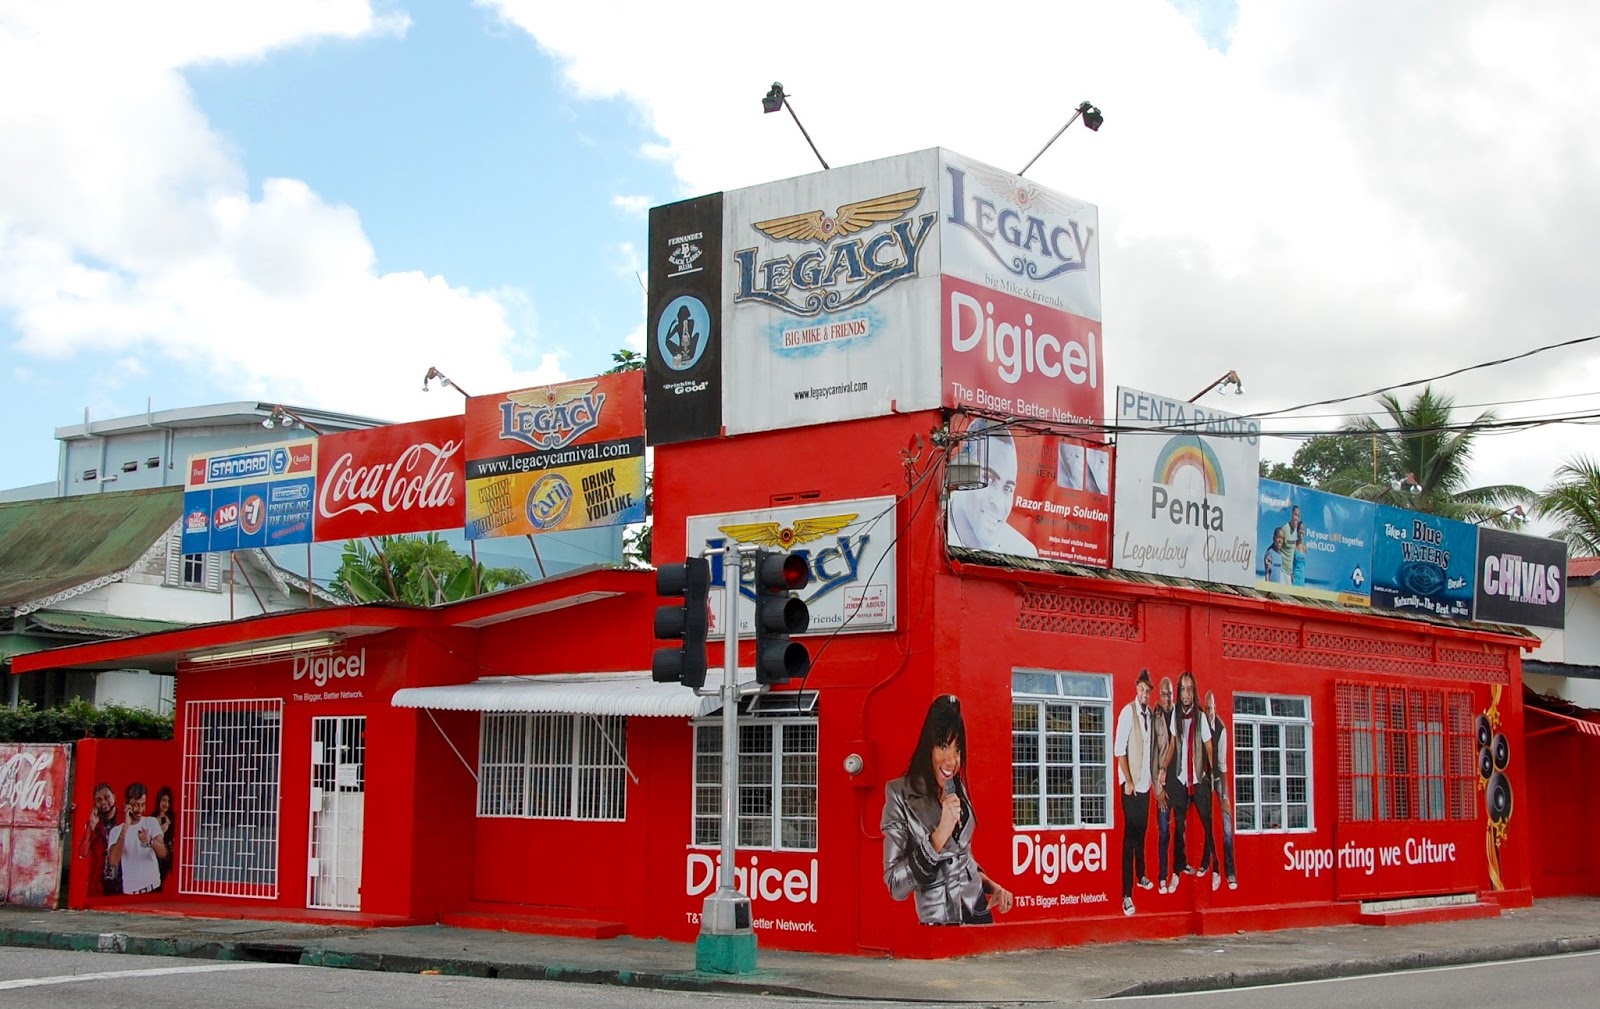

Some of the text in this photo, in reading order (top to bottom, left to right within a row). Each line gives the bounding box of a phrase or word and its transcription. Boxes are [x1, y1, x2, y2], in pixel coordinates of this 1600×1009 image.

[945, 165, 1094, 276] LEGACY
[668, 232, 703, 246] FERNANDES
[678, 263, 693, 271] RUM
[734, 212, 938, 312] LEGACY
[985, 273, 1064, 307] big Mike & Friends
[785, 319, 866, 346] BIG MIKE & FRIENDS
[951, 290, 1097, 389] Digicel
[794, 381, 868, 400] www.legacycarnival.com
[951, 382, 973, 401] The
[976, 388, 1014, 414] Bigger,
[1017, 399, 1050, 418] Better
[499, 393, 606, 446] LEGACY
[1123, 391, 1258, 446] PENTA PAINTS
[212, 456, 267, 476] STANDARD
[275, 453, 283, 469] S
[478, 442, 631, 475] www.legacycarnival.com
[319, 438, 464, 519] Coca-Cola
[478, 478, 509, 504] KNOW
[581, 467, 616, 492] DRINK
[487, 493, 512, 516] WHO
[530, 483, 573, 528] Carib
[584, 483, 615, 507] WHAT
[586, 502, 609, 521] YOU
[609, 493, 637, 514] LIKE.
[1015, 496, 1109, 522] Razor Bump Solution
[1151, 486, 1224, 532] Penta
[473, 515, 495, 535] YOU
[1384, 518, 1443, 546] Take a Blue
[1122, 531, 1252, 571] Legendary Quality
[1401, 541, 1450, 570] WATERS
[1483, 554, 1560, 604] CHIVAS
[1435, 603, 1449, 614] Best
[293, 647, 366, 687] Digicel
[293, 693, 303, 701] The
[324, 691, 340, 700] Better
[1012, 832, 1107, 885] Digicel
[1379, 845, 1401, 866] we
[1405, 837, 1456, 865] Culture
[1015, 892, 1109, 908] T&T's Bigger, Better Network.
[752, 917, 774, 930] etter
[776, 918, 817, 933] Network.
